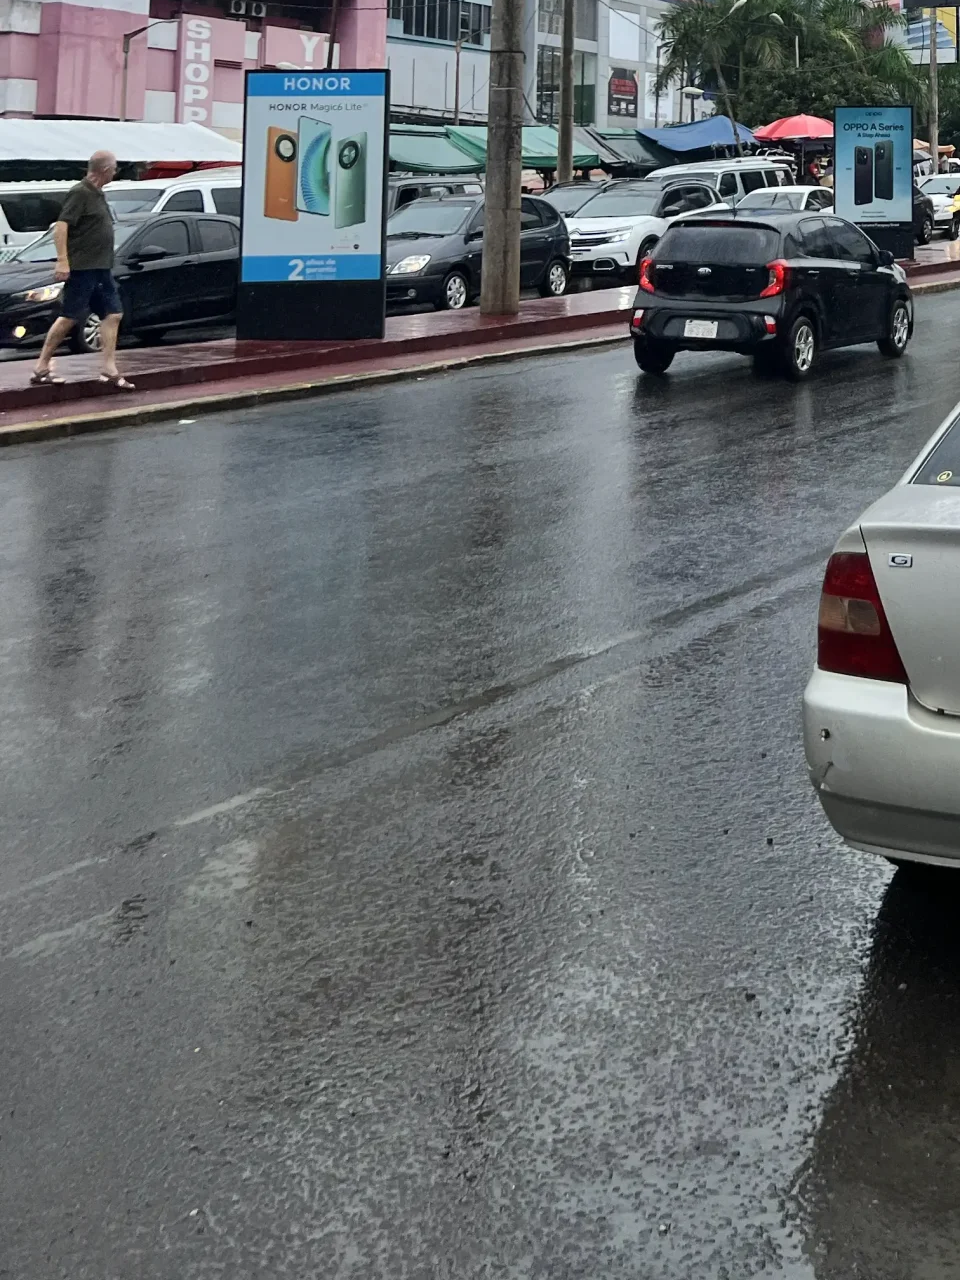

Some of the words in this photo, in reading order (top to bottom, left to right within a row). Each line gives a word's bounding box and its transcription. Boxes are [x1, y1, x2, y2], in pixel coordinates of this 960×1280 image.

[283, 77, 351, 91] HONOR
[269, 103, 307, 111] HONOR
[310, 103, 343, 113] Magic6
[345, 103, 362, 111] Lite
[843, 123, 868, 131] OPPO
[870, 123, 877, 131] A
[879, 123, 904, 131] Series
[288, 259, 305, 280] 2
[891, 556, 908, 565] G
